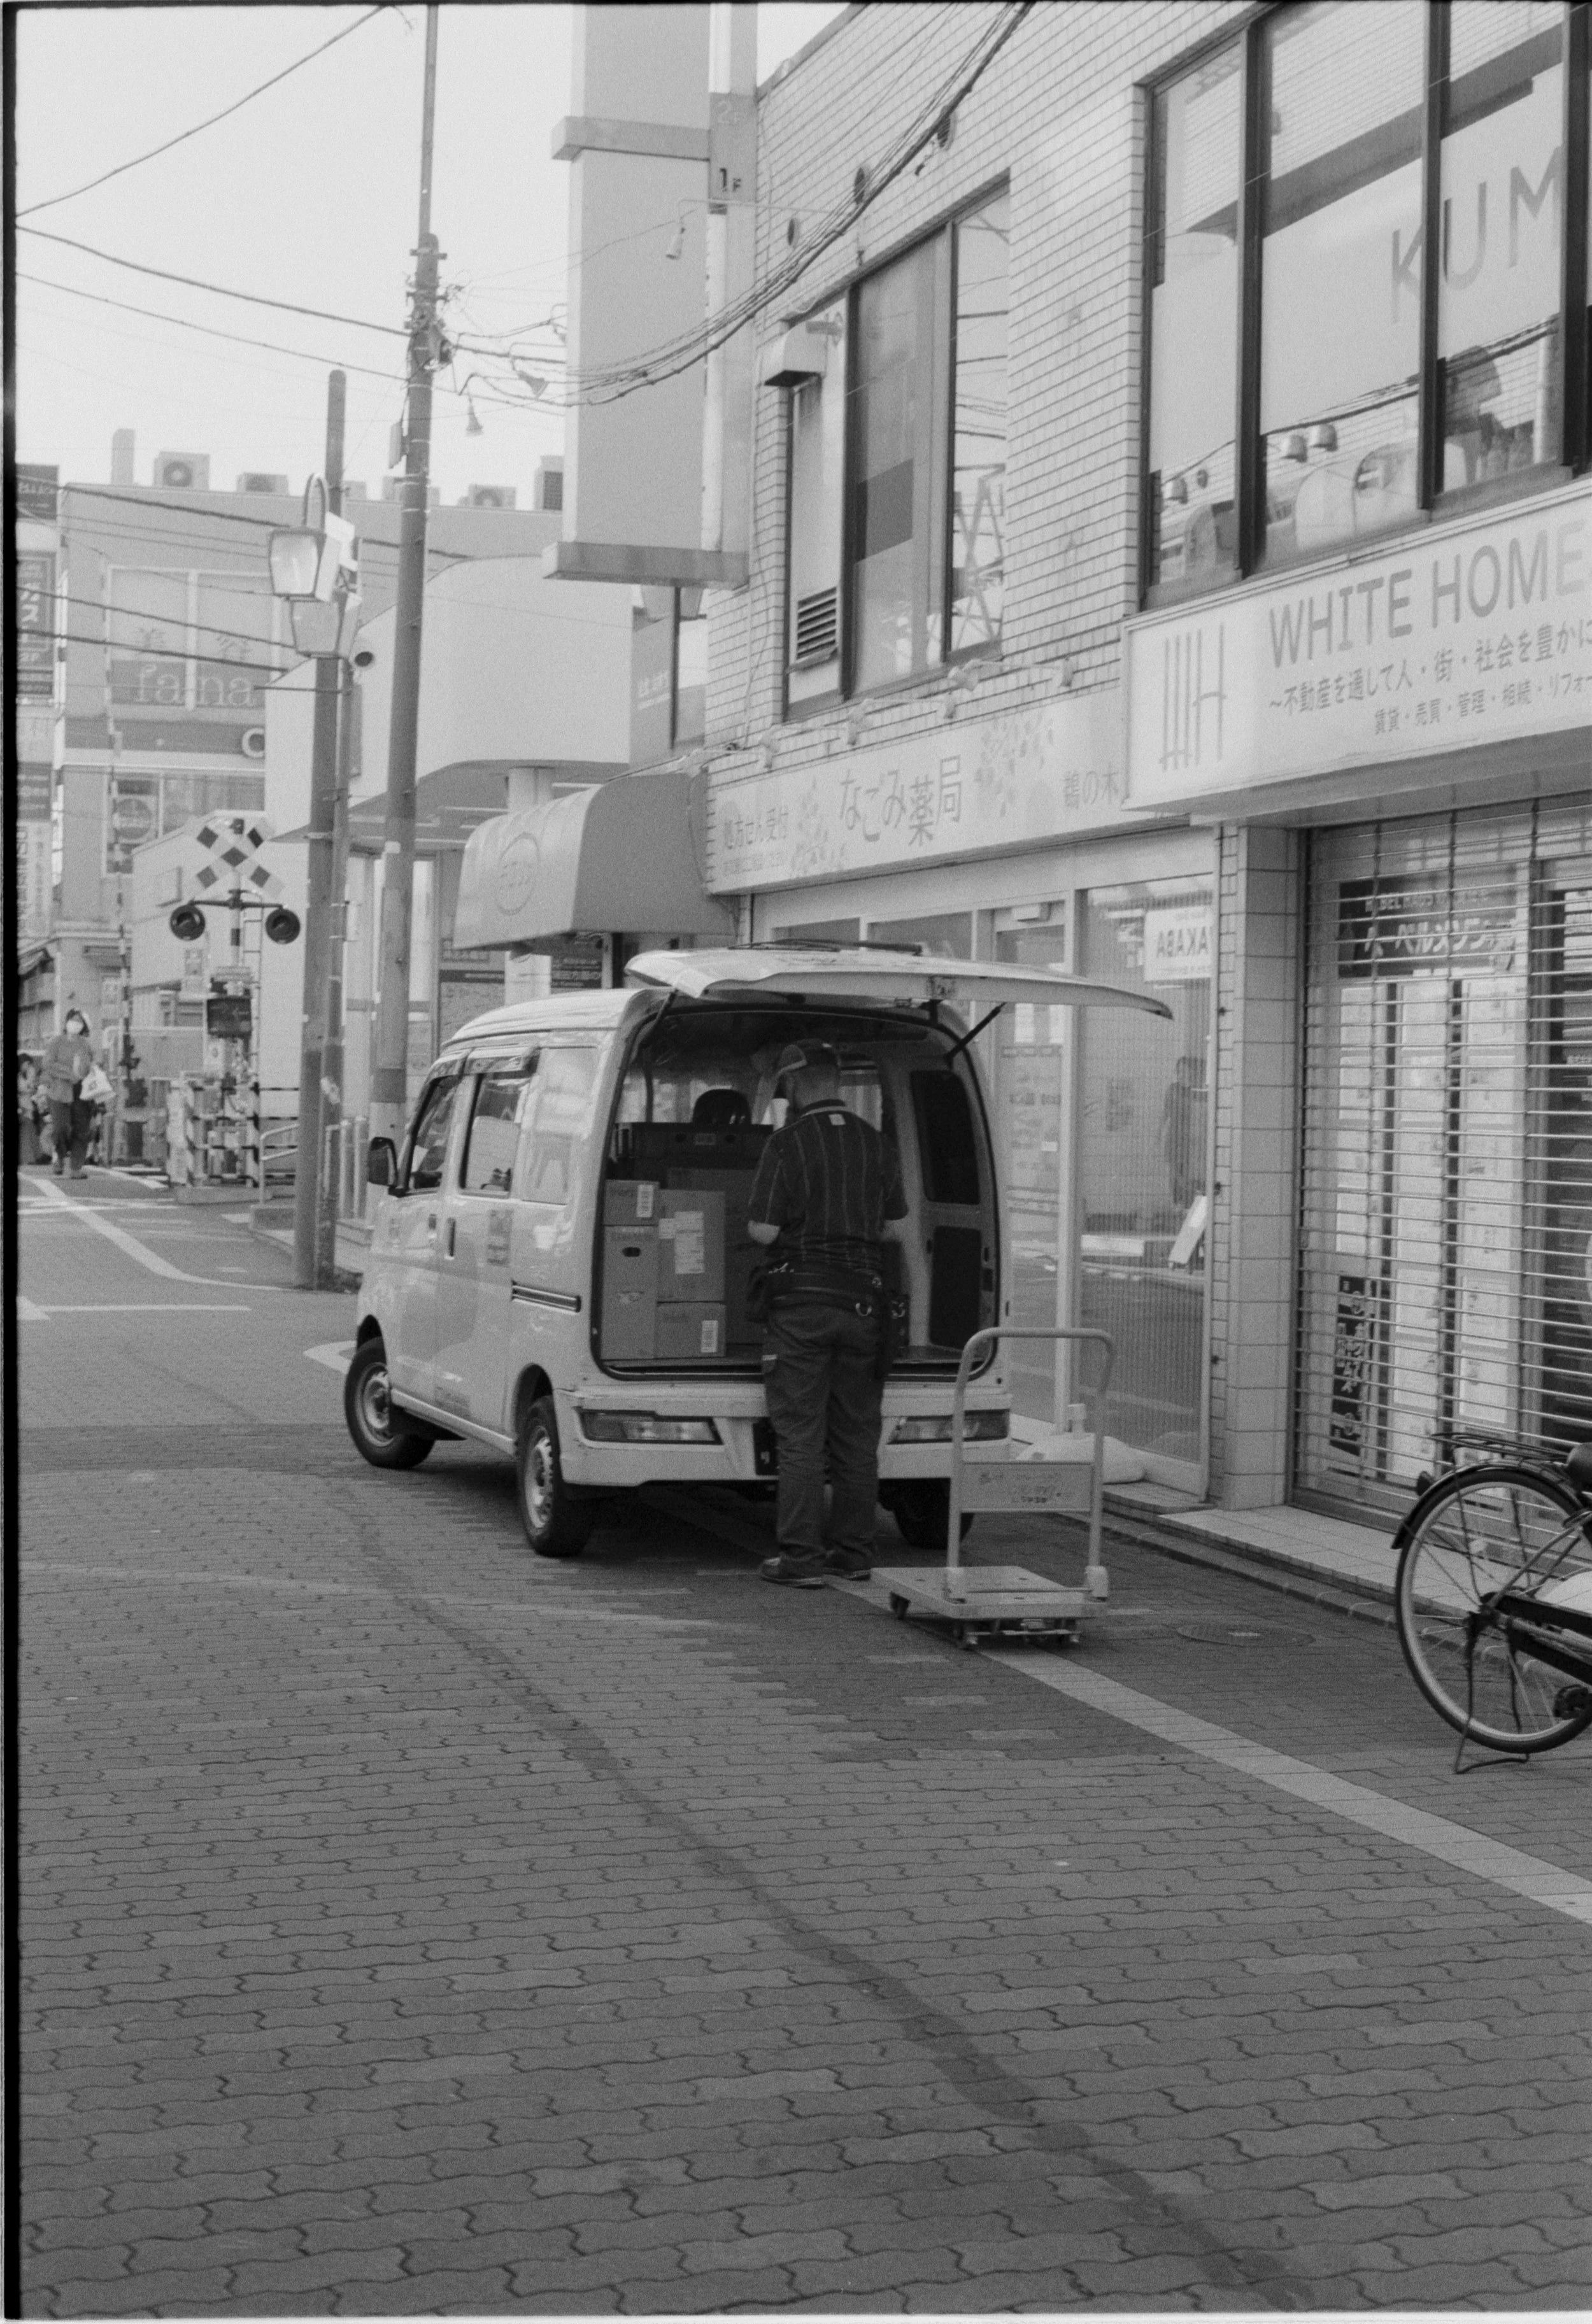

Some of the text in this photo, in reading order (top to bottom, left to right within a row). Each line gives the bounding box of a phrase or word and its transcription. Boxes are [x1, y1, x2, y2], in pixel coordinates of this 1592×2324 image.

[1270, 518, 1585, 669] WHITE HOME
[840, 755, 962, 847] なごみ薬局
